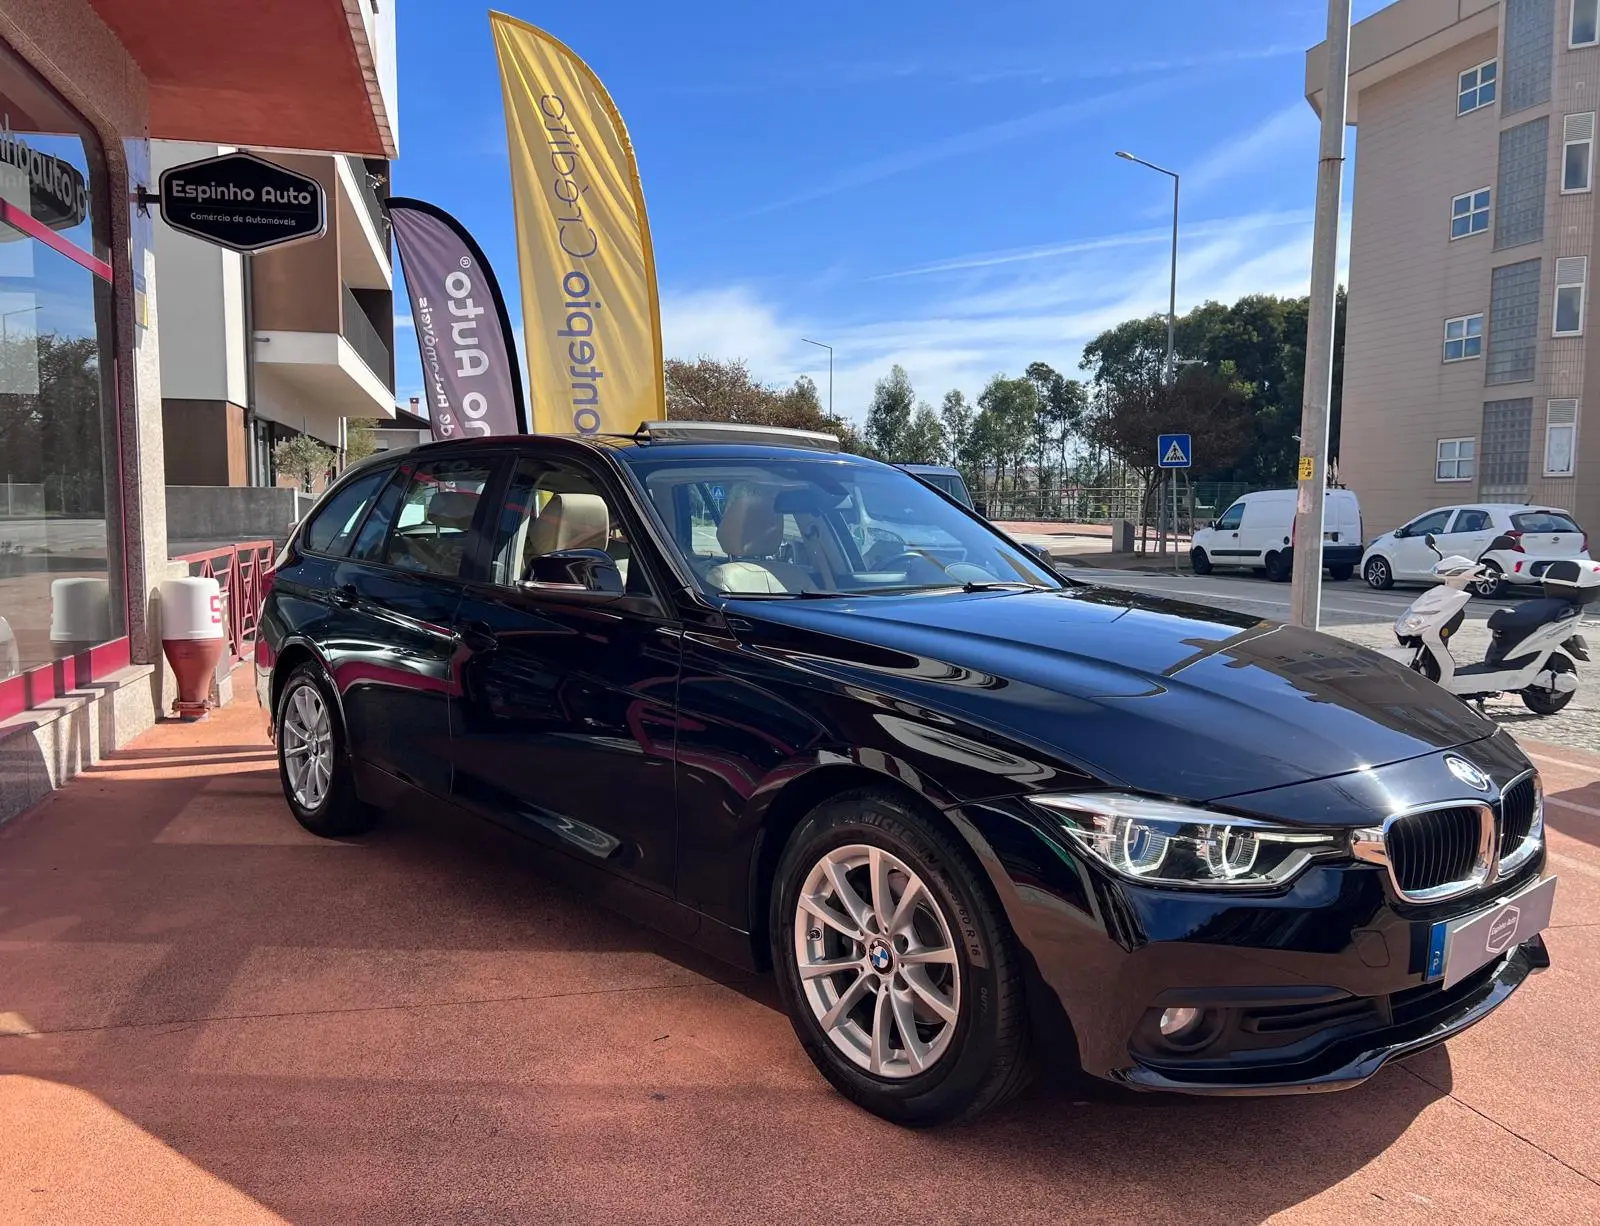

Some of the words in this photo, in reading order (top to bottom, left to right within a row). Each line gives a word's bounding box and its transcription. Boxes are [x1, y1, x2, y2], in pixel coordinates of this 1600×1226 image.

[171, 179, 255, 203] Espinho
[190, 211, 231, 222] Comércio
[232, 215, 244, 223] de
[245, 215, 296, 226] Automóveis
